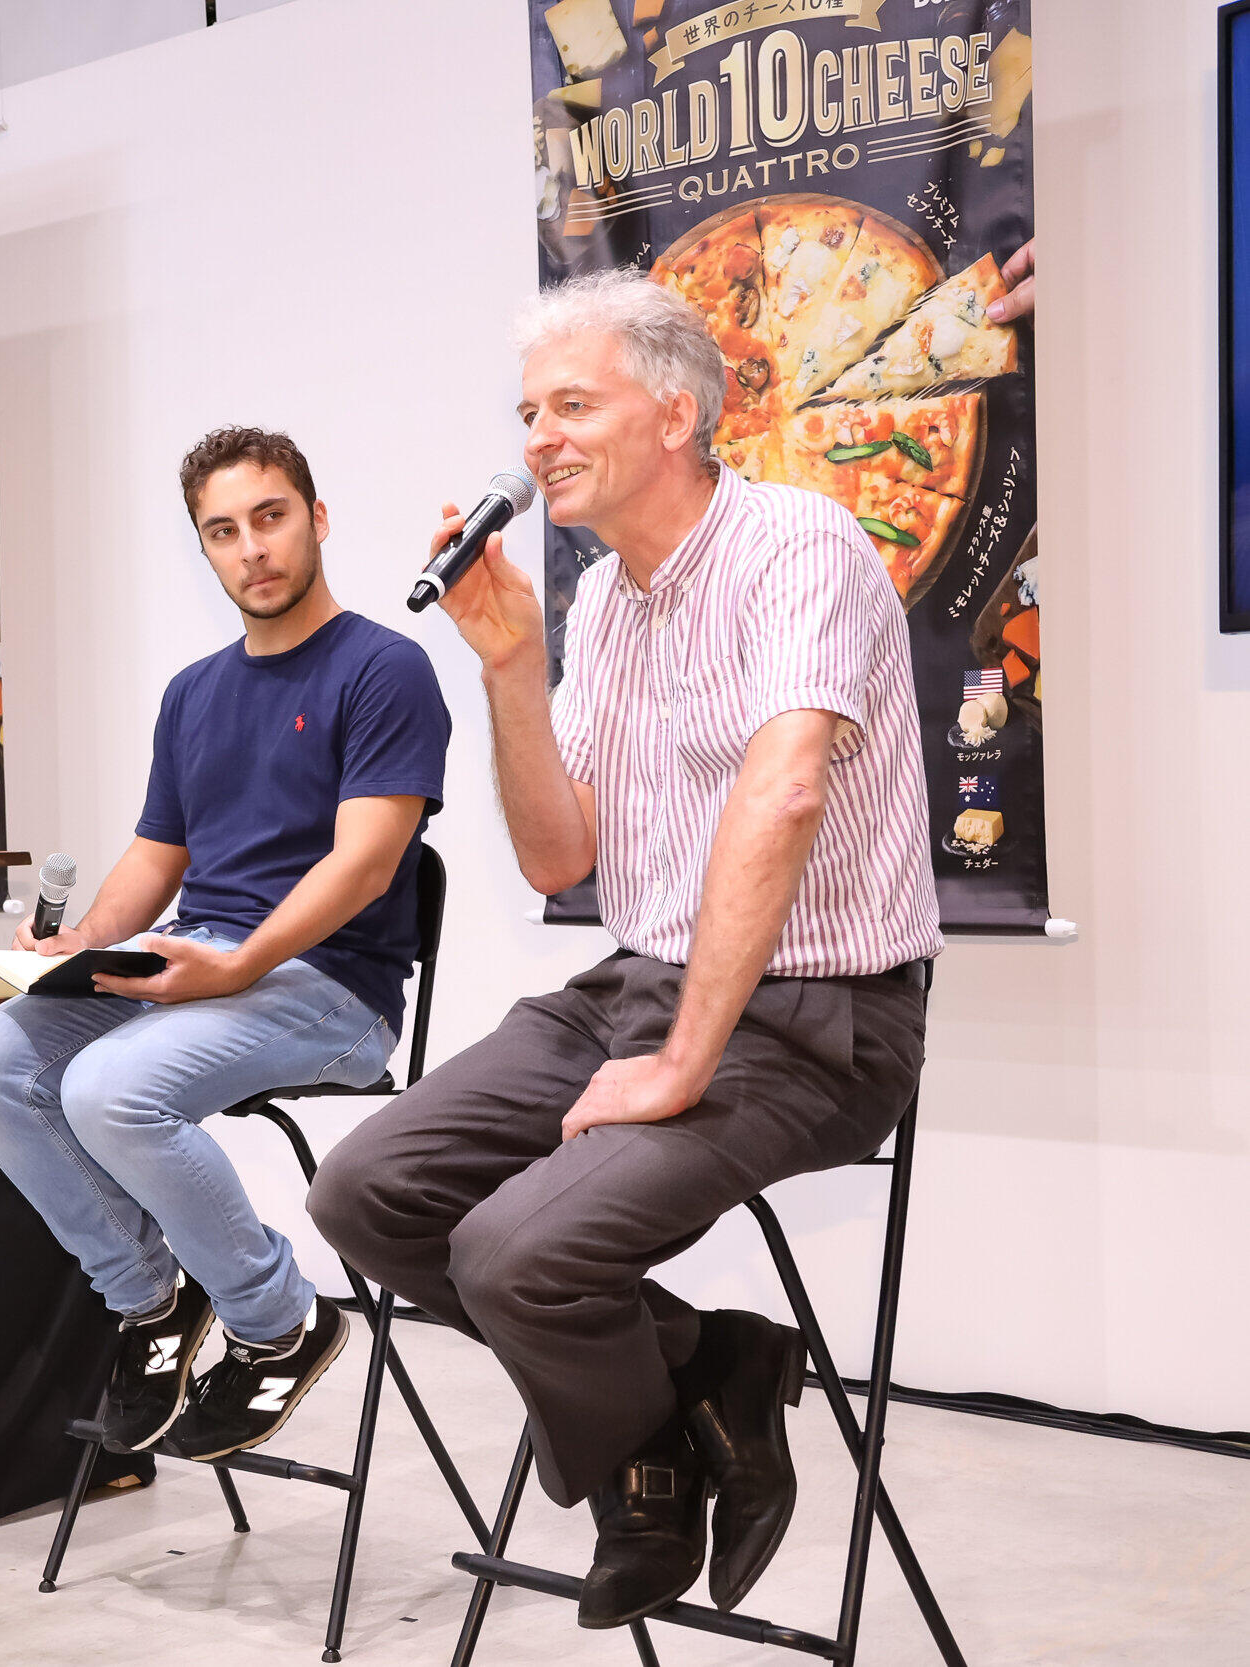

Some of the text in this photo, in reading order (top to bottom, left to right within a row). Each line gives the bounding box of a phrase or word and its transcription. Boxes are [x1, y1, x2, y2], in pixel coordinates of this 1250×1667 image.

[569, 30, 993, 190] WORLD 10 CHEESE
[678, 143, 861, 204] QUATTRO
[923, 181, 960, 229] プレミアム
[956, 749, 1003, 762] モッツァレラ
[963, 857, 999, 870] チェダー
